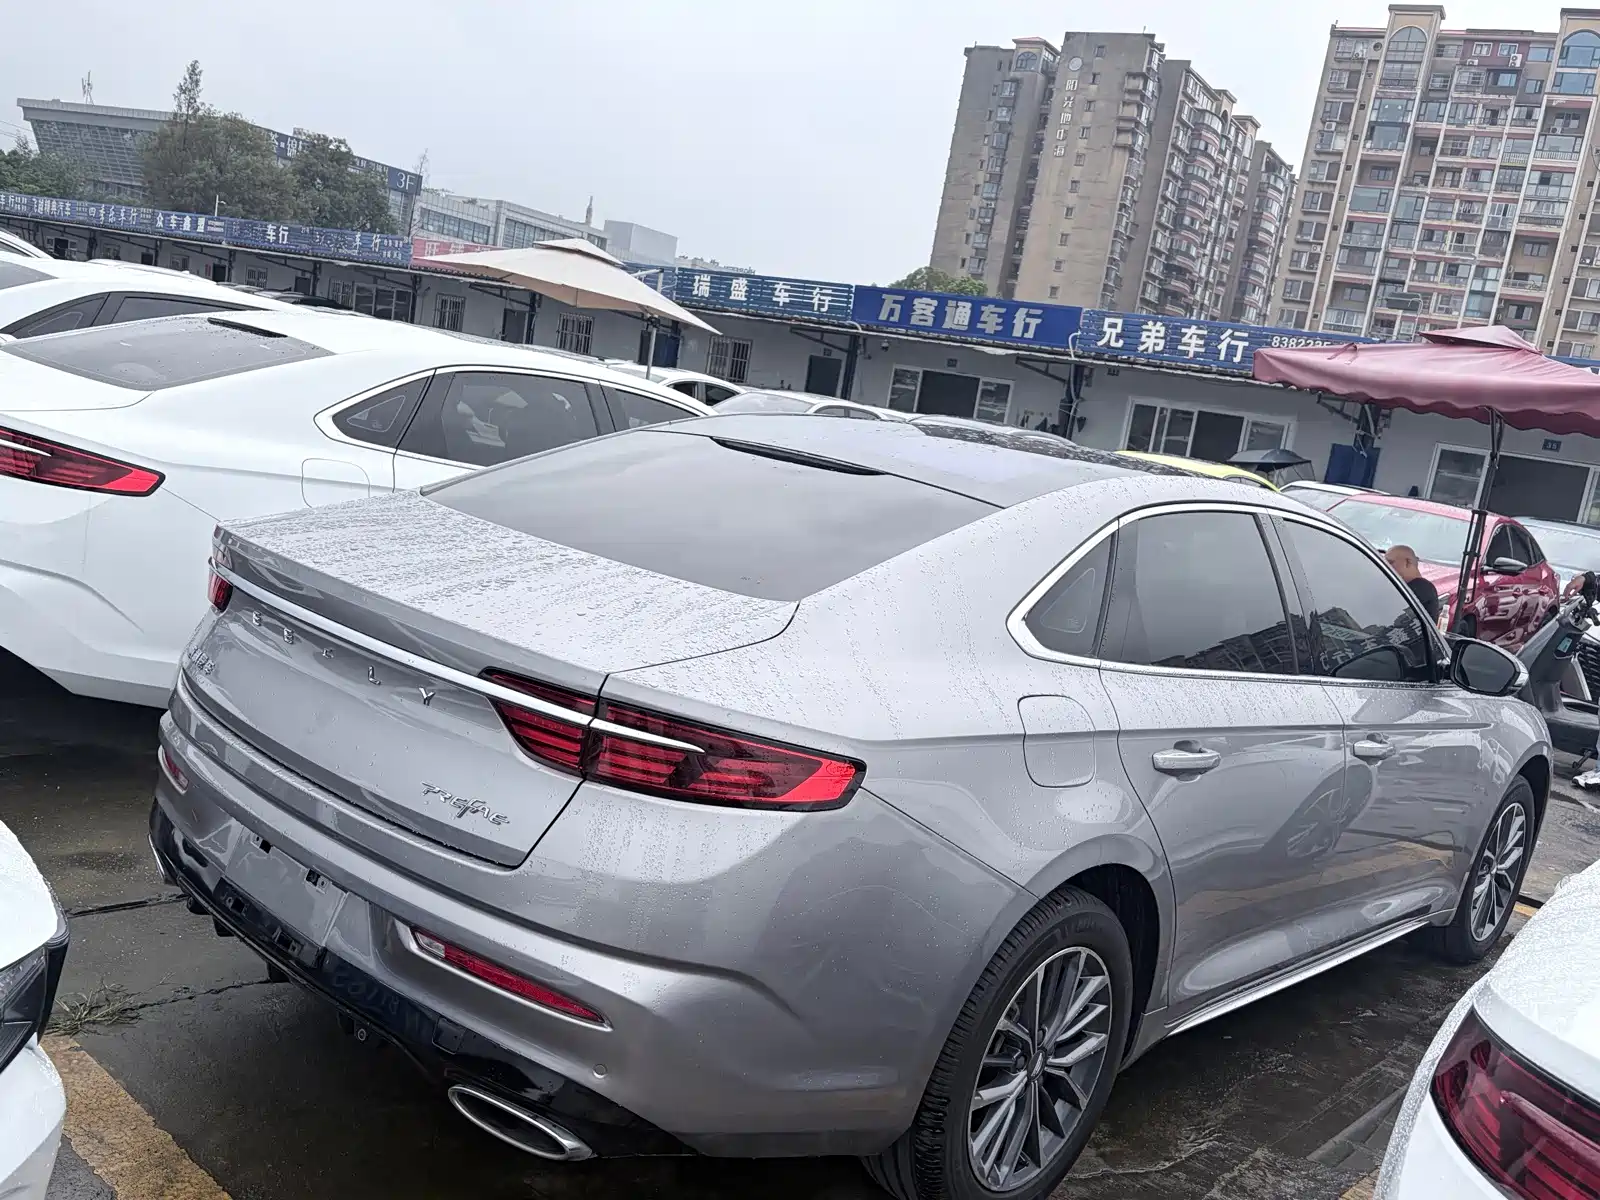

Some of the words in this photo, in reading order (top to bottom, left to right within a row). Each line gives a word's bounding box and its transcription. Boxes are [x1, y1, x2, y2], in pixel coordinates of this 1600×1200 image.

[396, 172, 416, 190] 3F
[692, 274, 832, 313] 瑞盛车行
[877, 293, 1044, 339] 万客通车行
[1096, 316, 1250, 363] 兄弟车行
